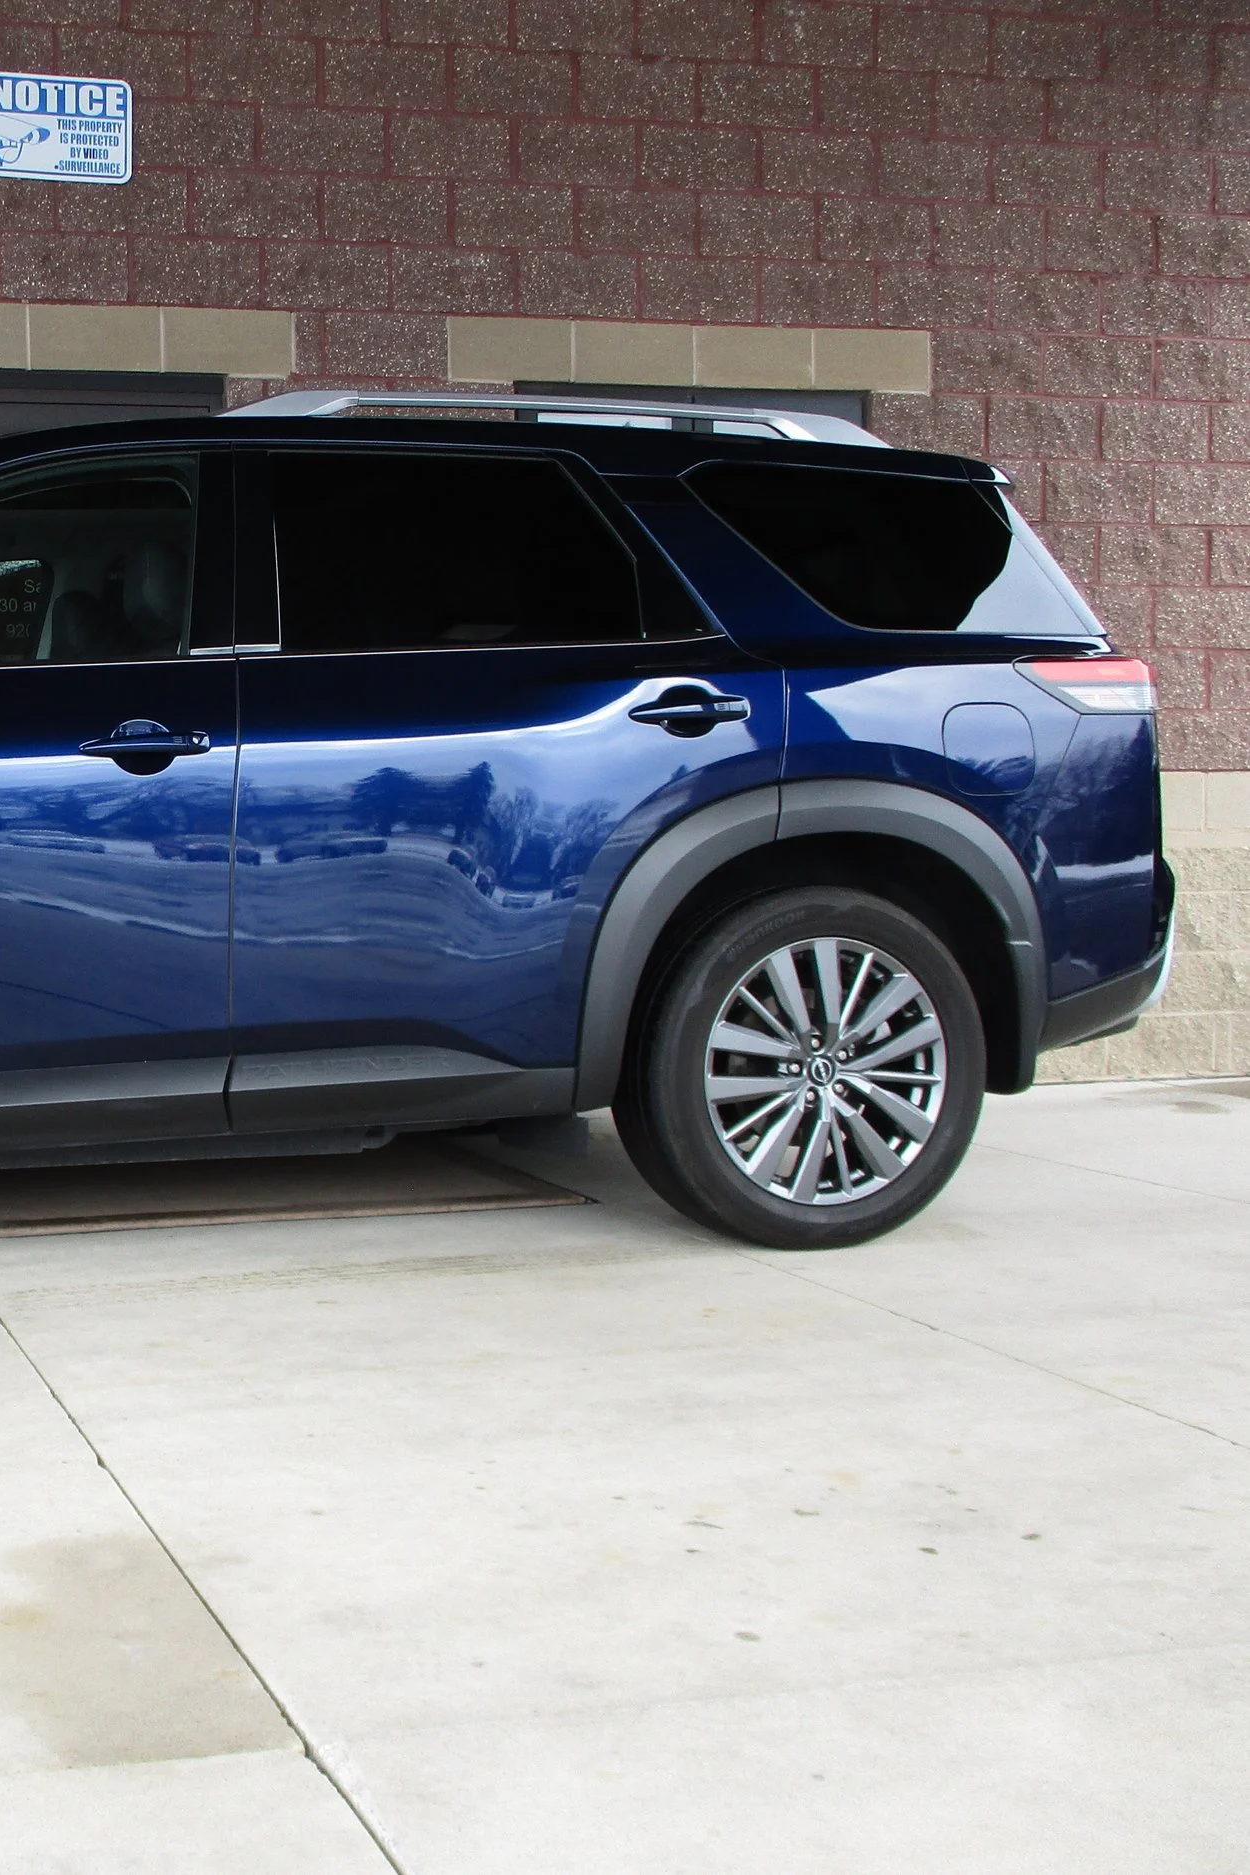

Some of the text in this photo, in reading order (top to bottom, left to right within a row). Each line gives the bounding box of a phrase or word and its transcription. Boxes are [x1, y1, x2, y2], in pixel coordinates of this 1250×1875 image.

[57, 118, 122, 133] THIS PROPERTY
[60, 133, 119, 147] IS PROTECTED
[70, 147, 109, 160] BY VIDEO
[58, 160, 121, 175] SURVEILLANCE
[23, 600, 37, 612] a
